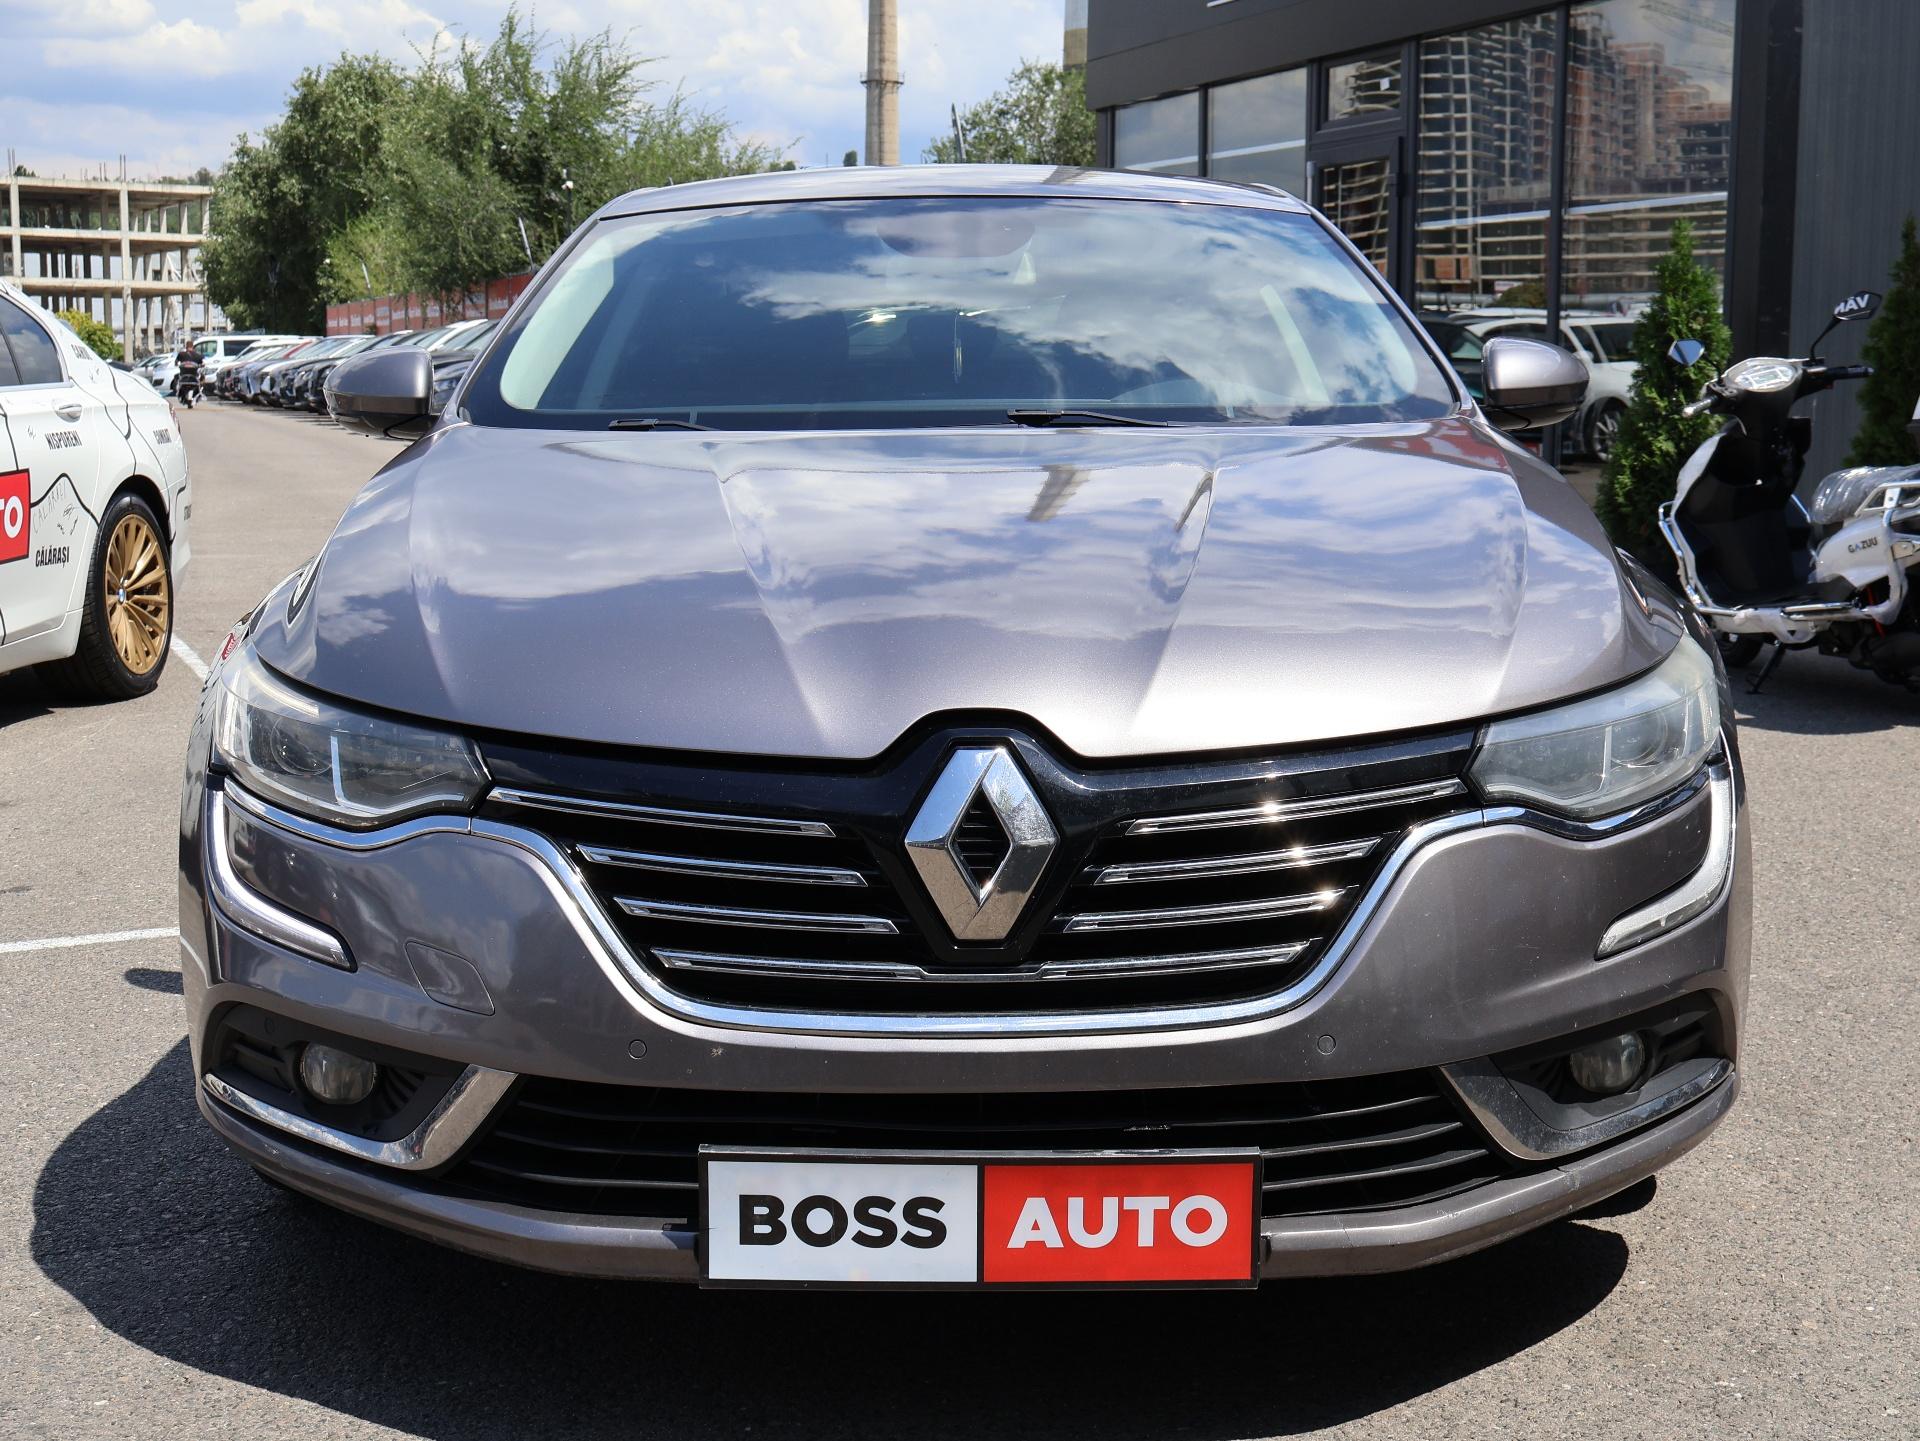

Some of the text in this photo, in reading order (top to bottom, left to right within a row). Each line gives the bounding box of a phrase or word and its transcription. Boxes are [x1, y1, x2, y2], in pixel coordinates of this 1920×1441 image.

[44, 430, 82, 450] NISPORENI
[738, 1193, 1229, 1249] BOSS AUTO
